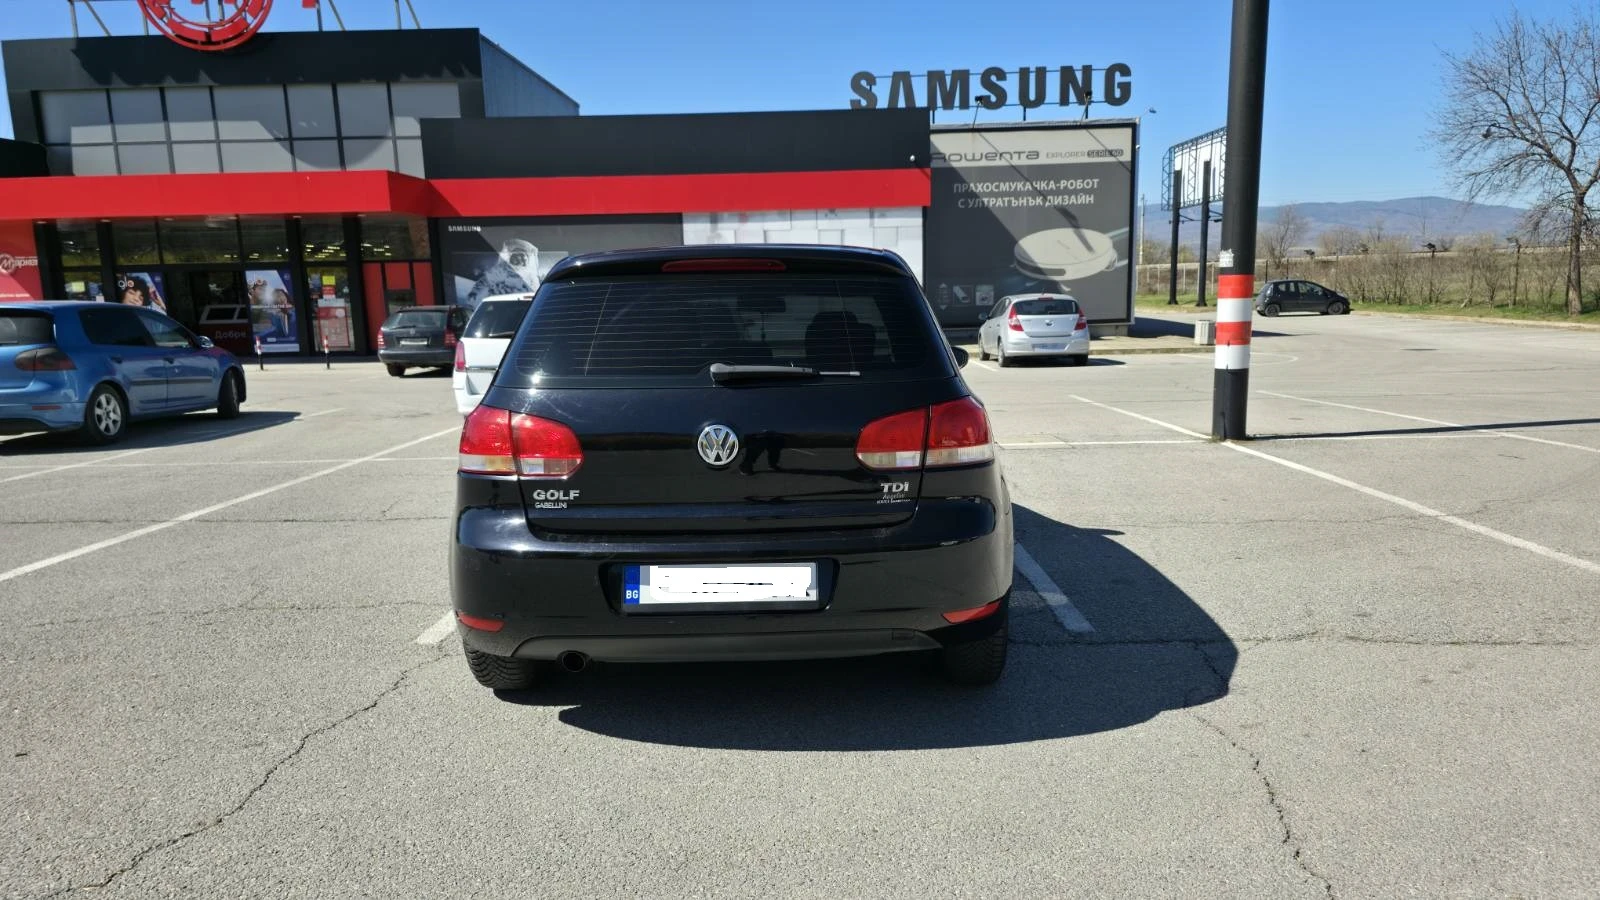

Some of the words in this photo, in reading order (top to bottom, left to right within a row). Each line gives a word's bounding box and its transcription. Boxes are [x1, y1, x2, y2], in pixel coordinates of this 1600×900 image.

[849, 62, 1132, 111] SAMSUNG
[953, 178, 1100, 194] ПРАХОСМУКАЧКА-РОБОТ
[968, 196, 1043, 208] УЛТРАТЪНЪК
[1045, 193, 1095, 207] ДИЗАЙН
[532, 489, 580, 500] GOLF
[625, 590, 639, 599] BG
